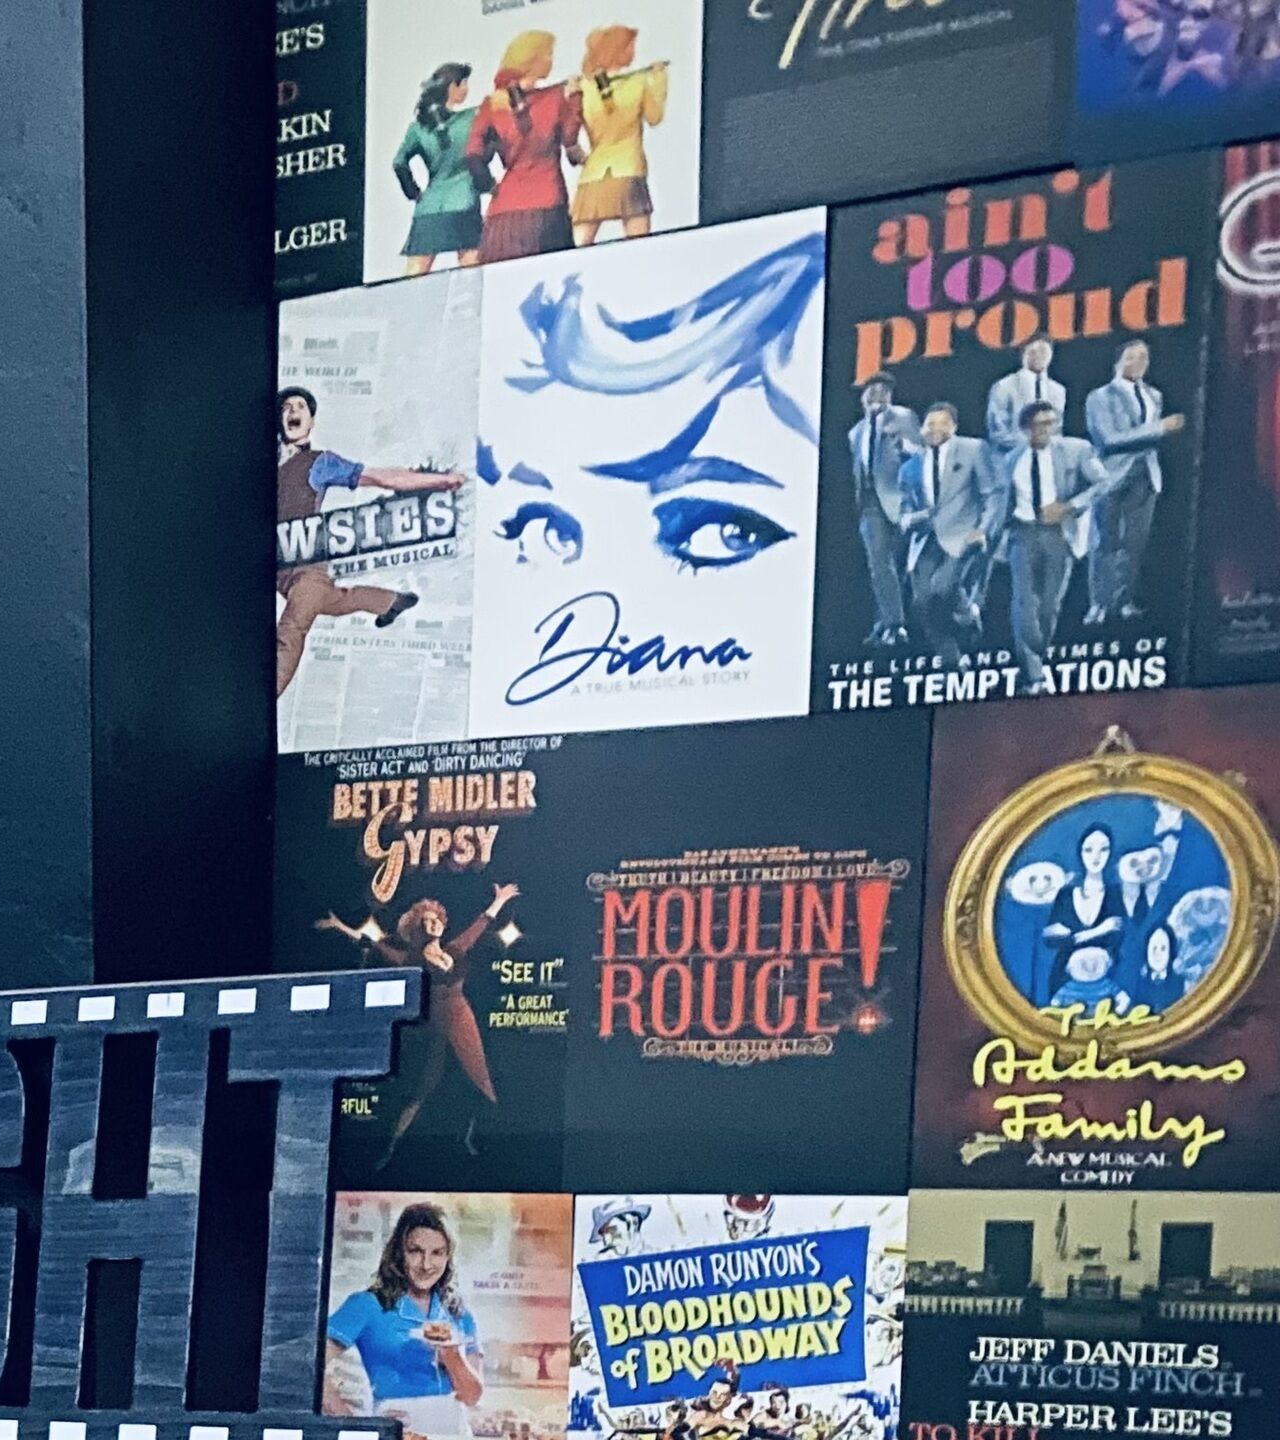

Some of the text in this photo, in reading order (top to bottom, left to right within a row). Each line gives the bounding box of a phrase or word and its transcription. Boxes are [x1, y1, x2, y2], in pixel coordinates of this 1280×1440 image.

[872, 167, 1114, 264] ain't
[906, 242, 1076, 313] too
[854, 257, 1189, 388] proud
[332, 544, 454, 577] THE MUSICAL
[505, 590, 752, 706] Diana
[829, 636, 1168, 679] THE LIFE AND TIMES OF
[628, 675, 696, 693] MUSICAL
[828, 676, 892, 710] THE
[407, 758, 429, 773] AND
[451, 742, 477, 755] FROM
[479, 740, 497, 752] THE
[500, 737, 548, 752] DIRECTOR
[333, 770, 537, 820] BETTE MIDLER
[363, 801, 500, 903] GYPSY
[679, 868, 738, 885] BEAUTY
[752, 864, 826, 882] FREEDOM
[602, 880, 847, 960] MOULIN
[517, 994, 553, 1010] GREAT
[598, 956, 843, 1039] ROUGE
[1040, 999, 1163, 1036] The
[973, 1037, 1246, 1088] Addams
[993, 1093, 1226, 1168] Family
[1088, 1152, 1167, 1167] MUSICAL
[624, 1238, 822, 1296] DAMON RUNYON'S
[599, 1275, 853, 1346] BLOODHOUNDS
[610, 1319, 847, 1390] of BROADWAY
[969, 1336, 1220, 1369] JEFF DANIELS
[970, 1363, 1246, 1397] ATTICUS FINCH
[967, 1400, 1233, 1437] HARPER LEE'S
